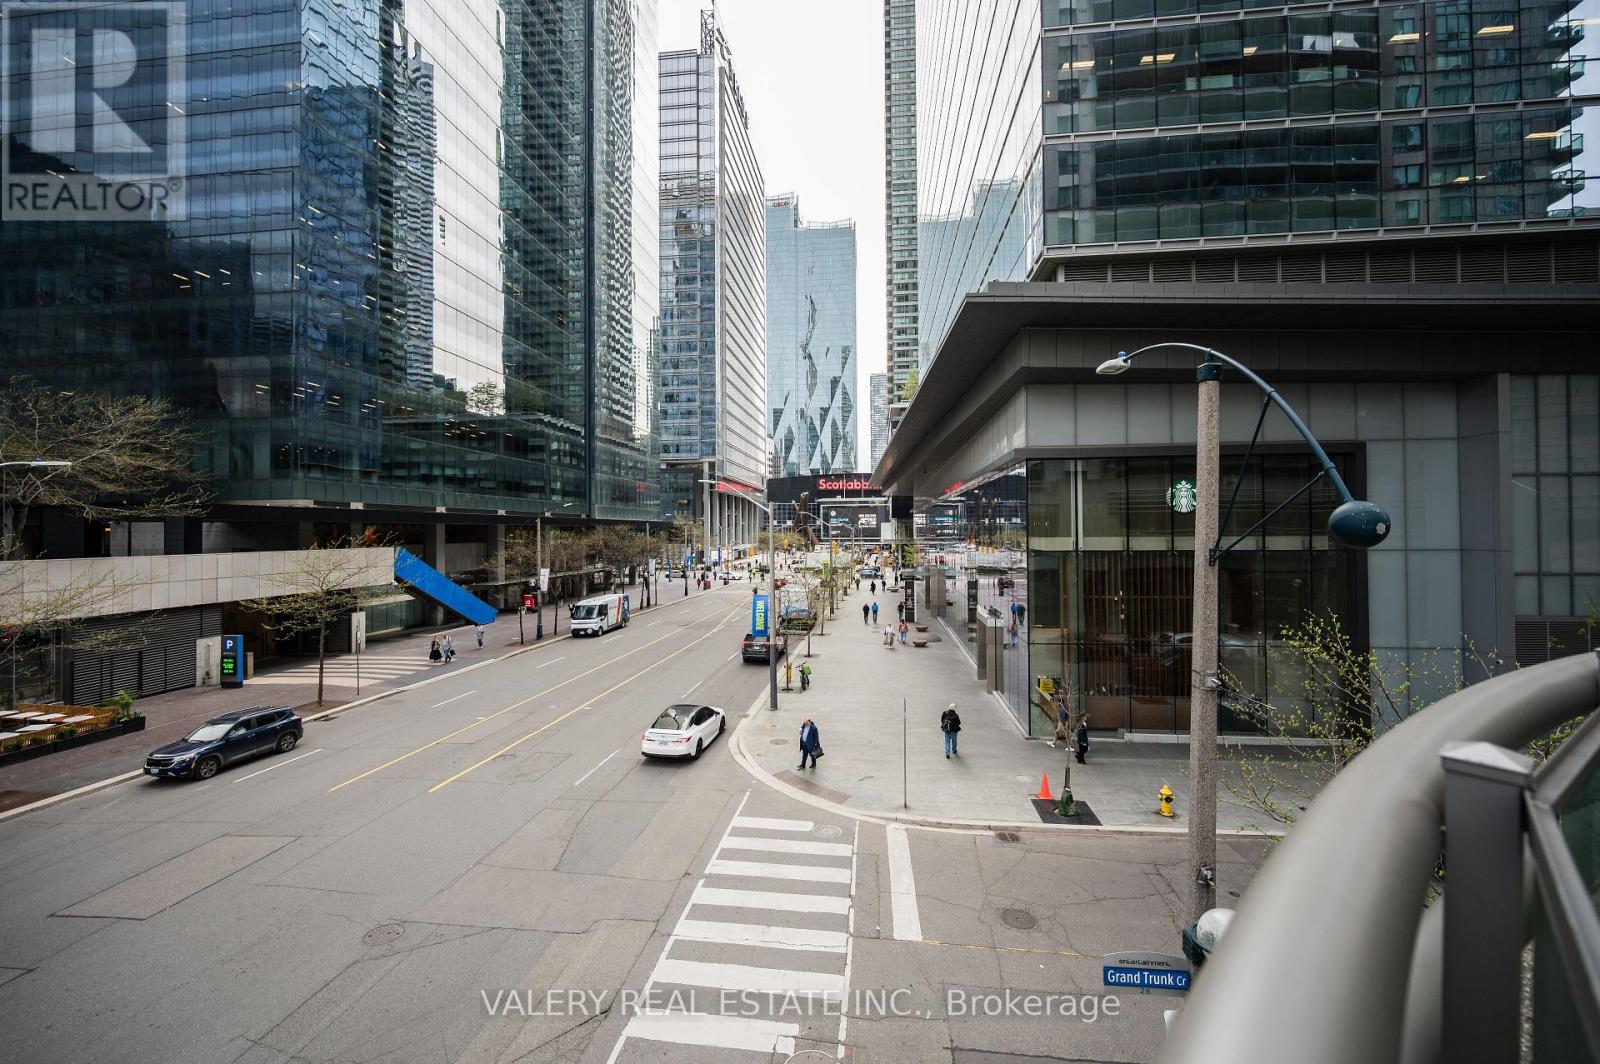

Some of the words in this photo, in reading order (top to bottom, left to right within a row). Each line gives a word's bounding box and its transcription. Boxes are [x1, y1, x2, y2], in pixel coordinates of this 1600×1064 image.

[818, 479, 883, 490] Scotiaba
[755, 600, 765, 631] WELCOME
[226, 640, 234, 649] P
[1107, 970, 1140, 984] Grand
[1143, 972, 1174, 986] Trunk
[1176, 976, 1187, 986] Cr
